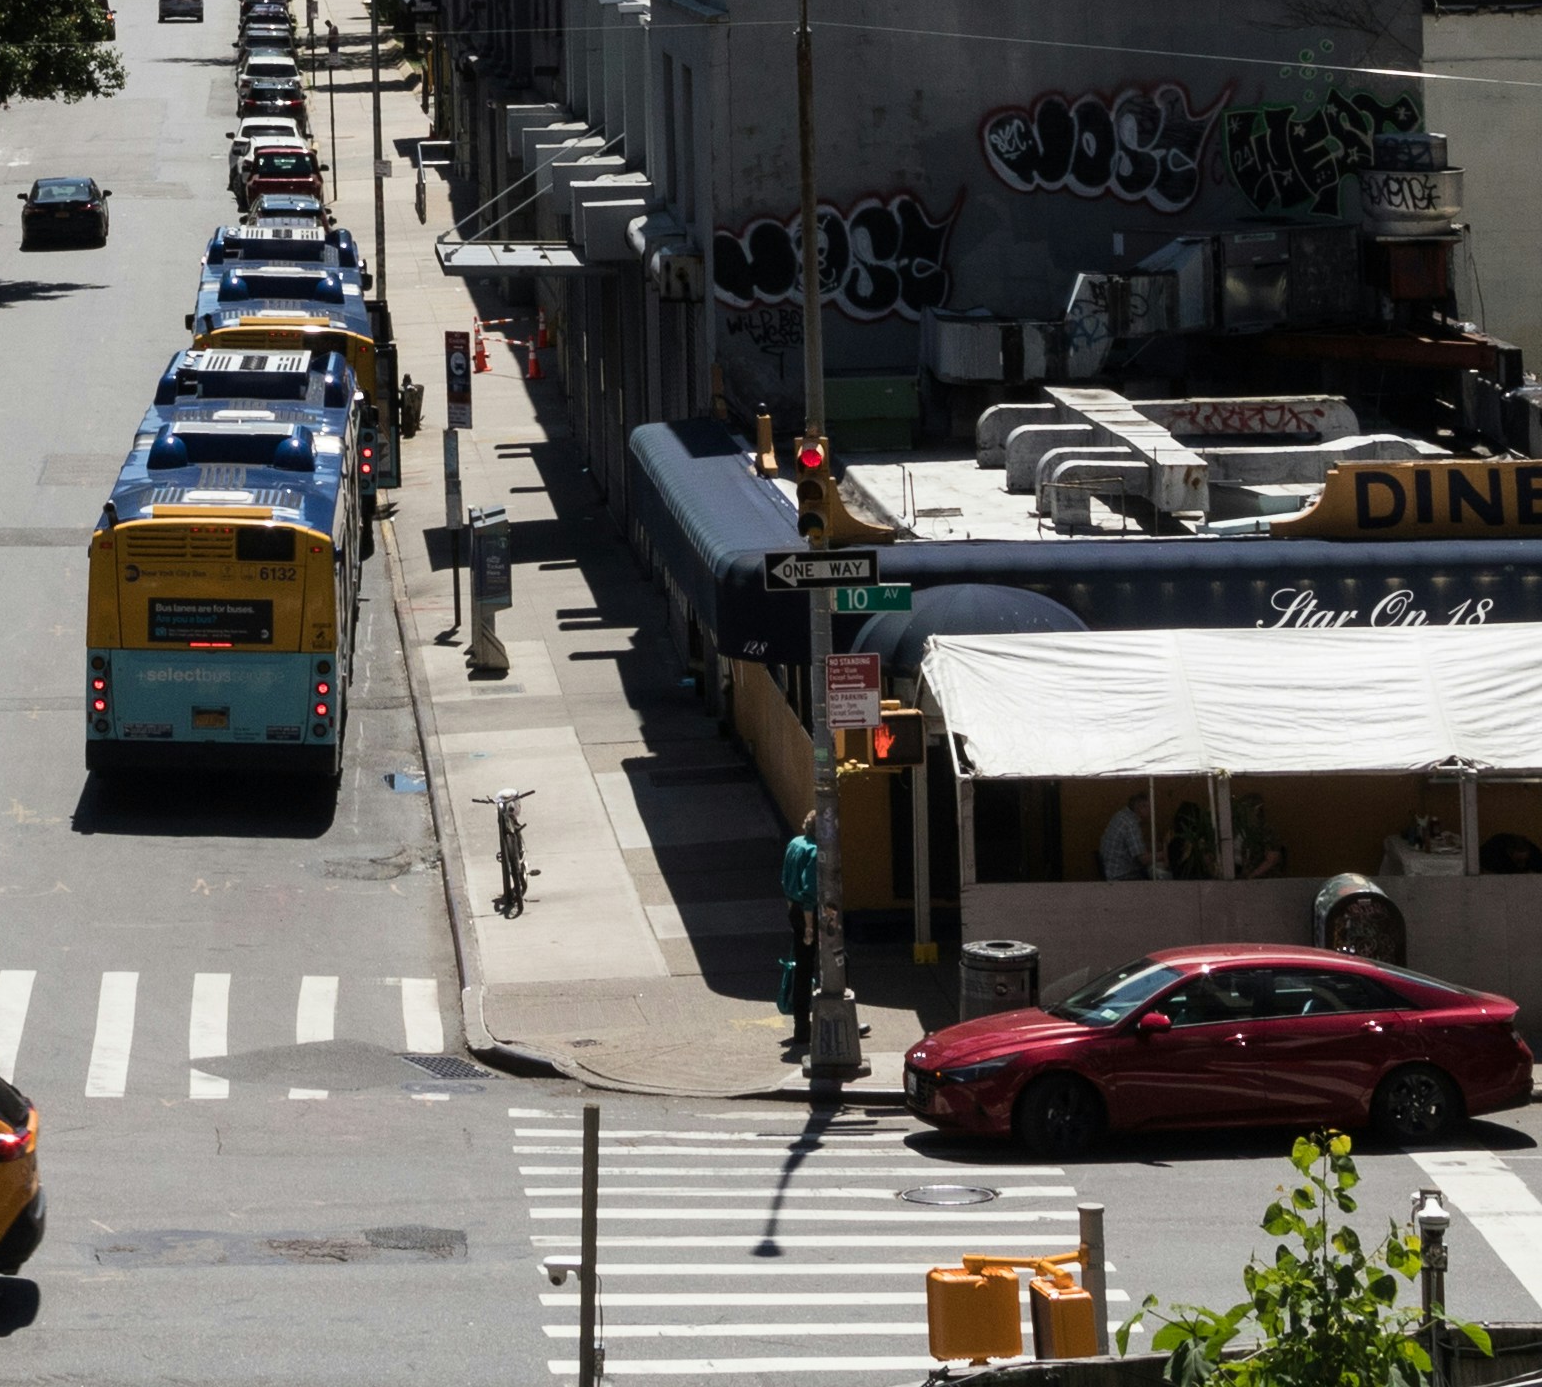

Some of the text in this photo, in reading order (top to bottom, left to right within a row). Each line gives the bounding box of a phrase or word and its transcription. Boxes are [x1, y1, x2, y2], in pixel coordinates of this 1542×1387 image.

[259, 567, 297, 581] 6132
[782, 561, 864, 578] ONE WAY
[846, 588, 900, 609] 10 AV
[155, 603, 255, 615] Bus lanes are for buses.
[1256, 588, 1495, 629] Star On 18
[170, 616, 187, 626] you
[742, 640, 768, 656] 128
[840, 657, 871, 666] STANDING
